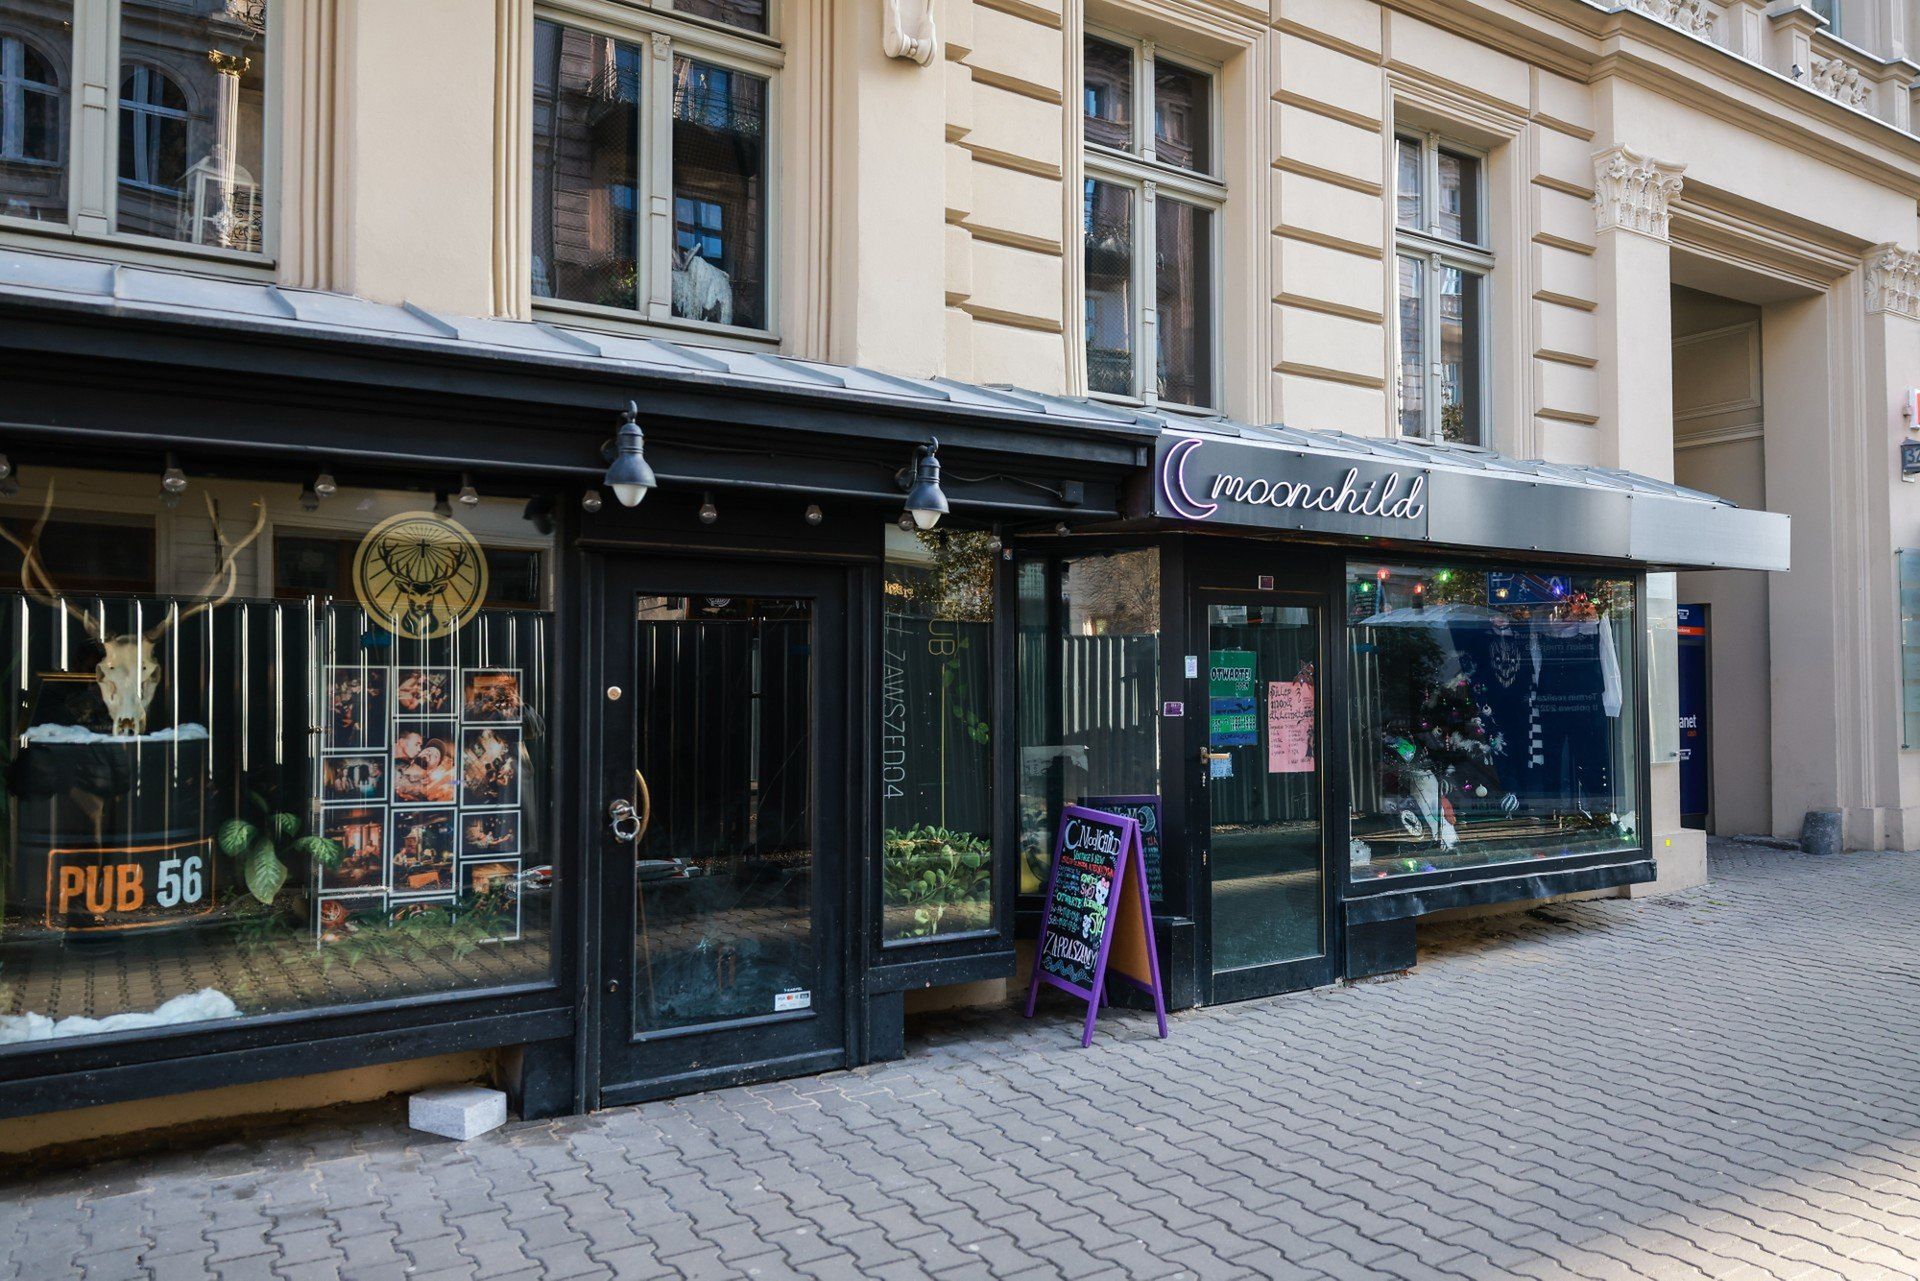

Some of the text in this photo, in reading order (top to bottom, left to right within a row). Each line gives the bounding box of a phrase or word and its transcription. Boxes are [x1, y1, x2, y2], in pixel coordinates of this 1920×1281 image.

[1211, 467, 1424, 520] moonchild
[1210, 667, 1252, 682] OTWARTE!
[1679, 715, 1697, 729] anet
[58, 855, 203, 914] PUB 56
